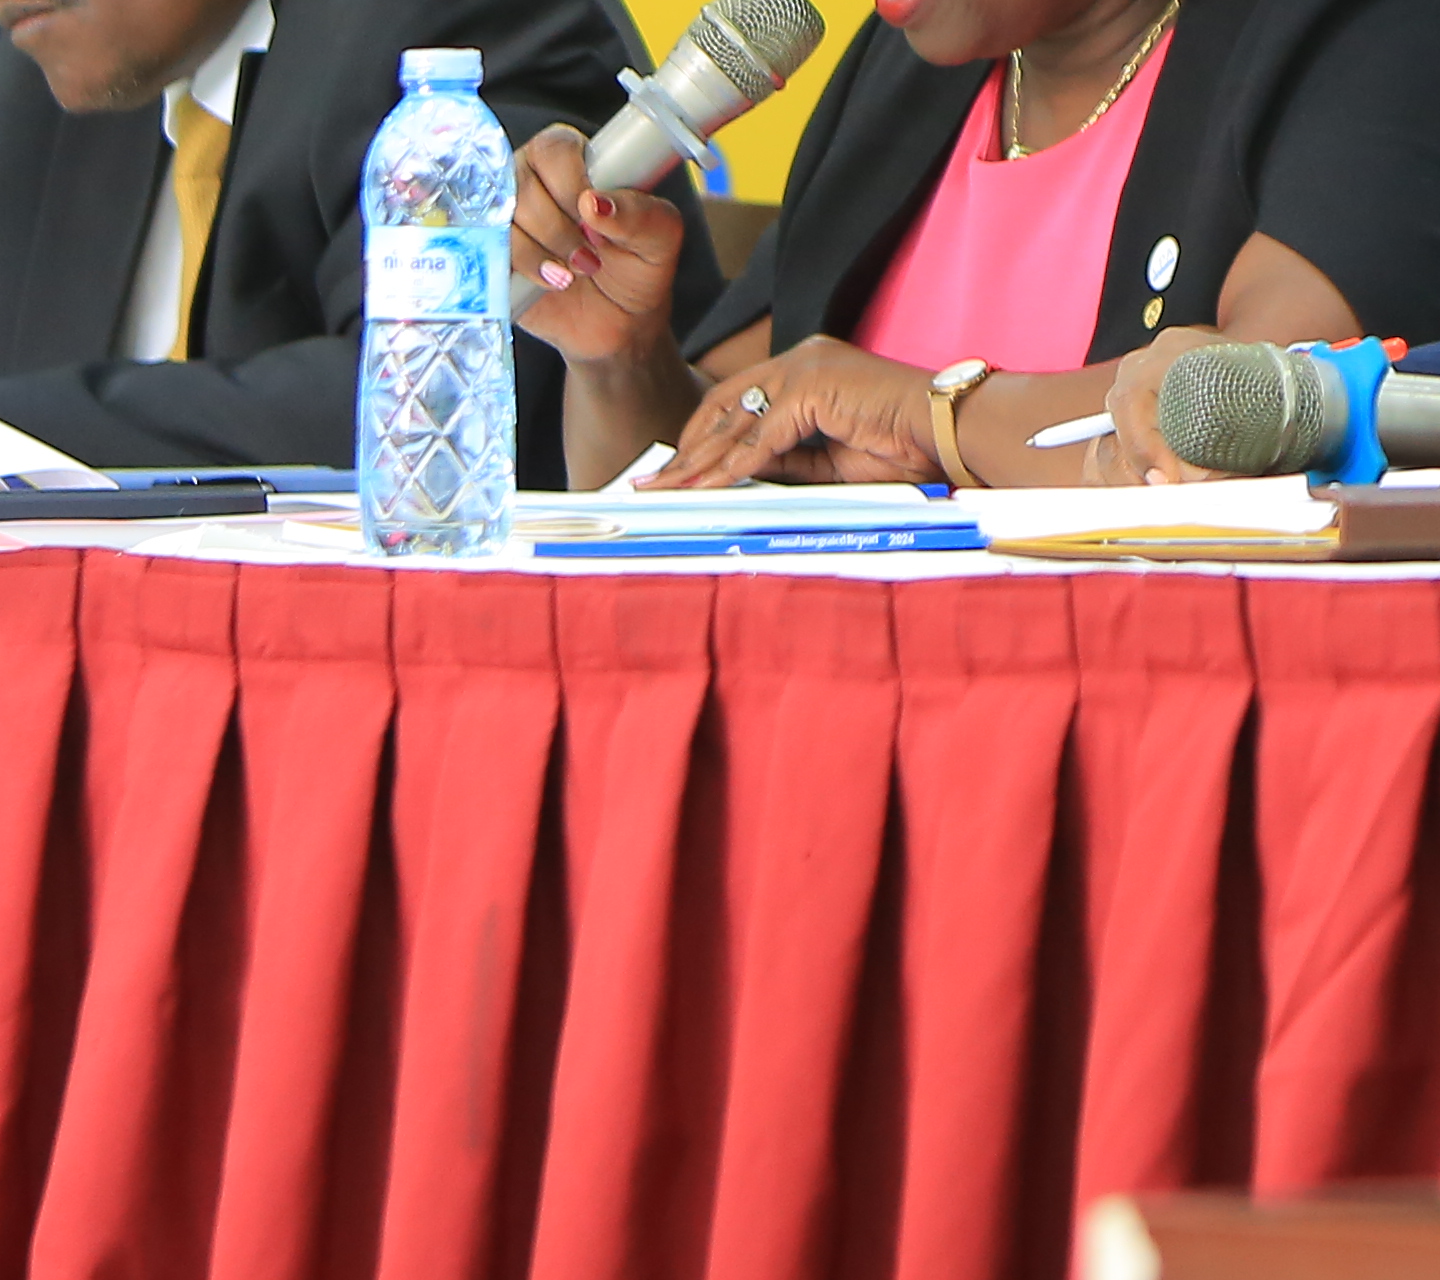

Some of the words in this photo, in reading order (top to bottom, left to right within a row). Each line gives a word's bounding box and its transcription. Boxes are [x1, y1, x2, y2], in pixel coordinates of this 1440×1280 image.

[384, 249, 446, 270] niana
[768, 535, 800, 547] Annual
[801, 534, 846, 549] Integrated
[847, 533, 879, 550] Report
[888, 532, 915, 546] 2024
